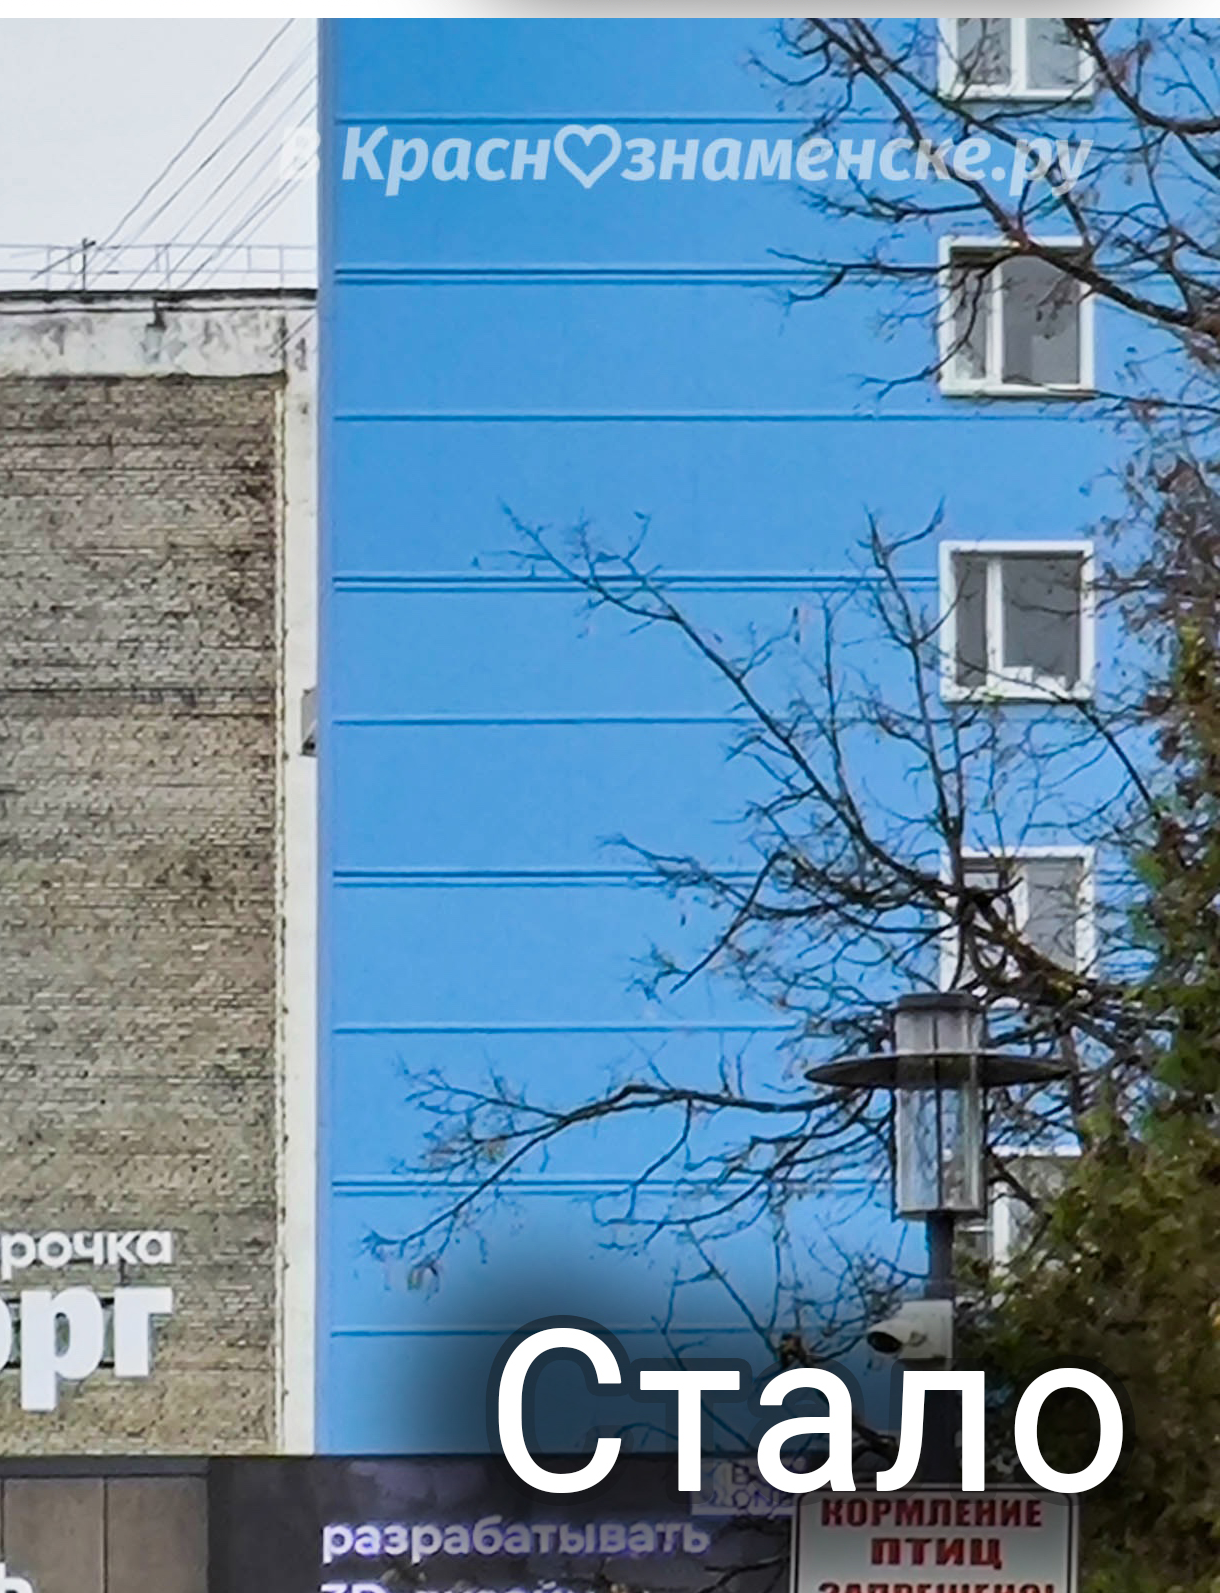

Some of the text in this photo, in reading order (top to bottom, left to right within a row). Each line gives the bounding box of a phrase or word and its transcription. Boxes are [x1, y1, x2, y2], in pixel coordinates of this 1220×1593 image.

[820, 1498, 1043, 1528] КОРМЛЕНИЕ
[322, 1515, 711, 1565] разрабатывать
[870, 1537, 1003, 1571] ПТИЦ
